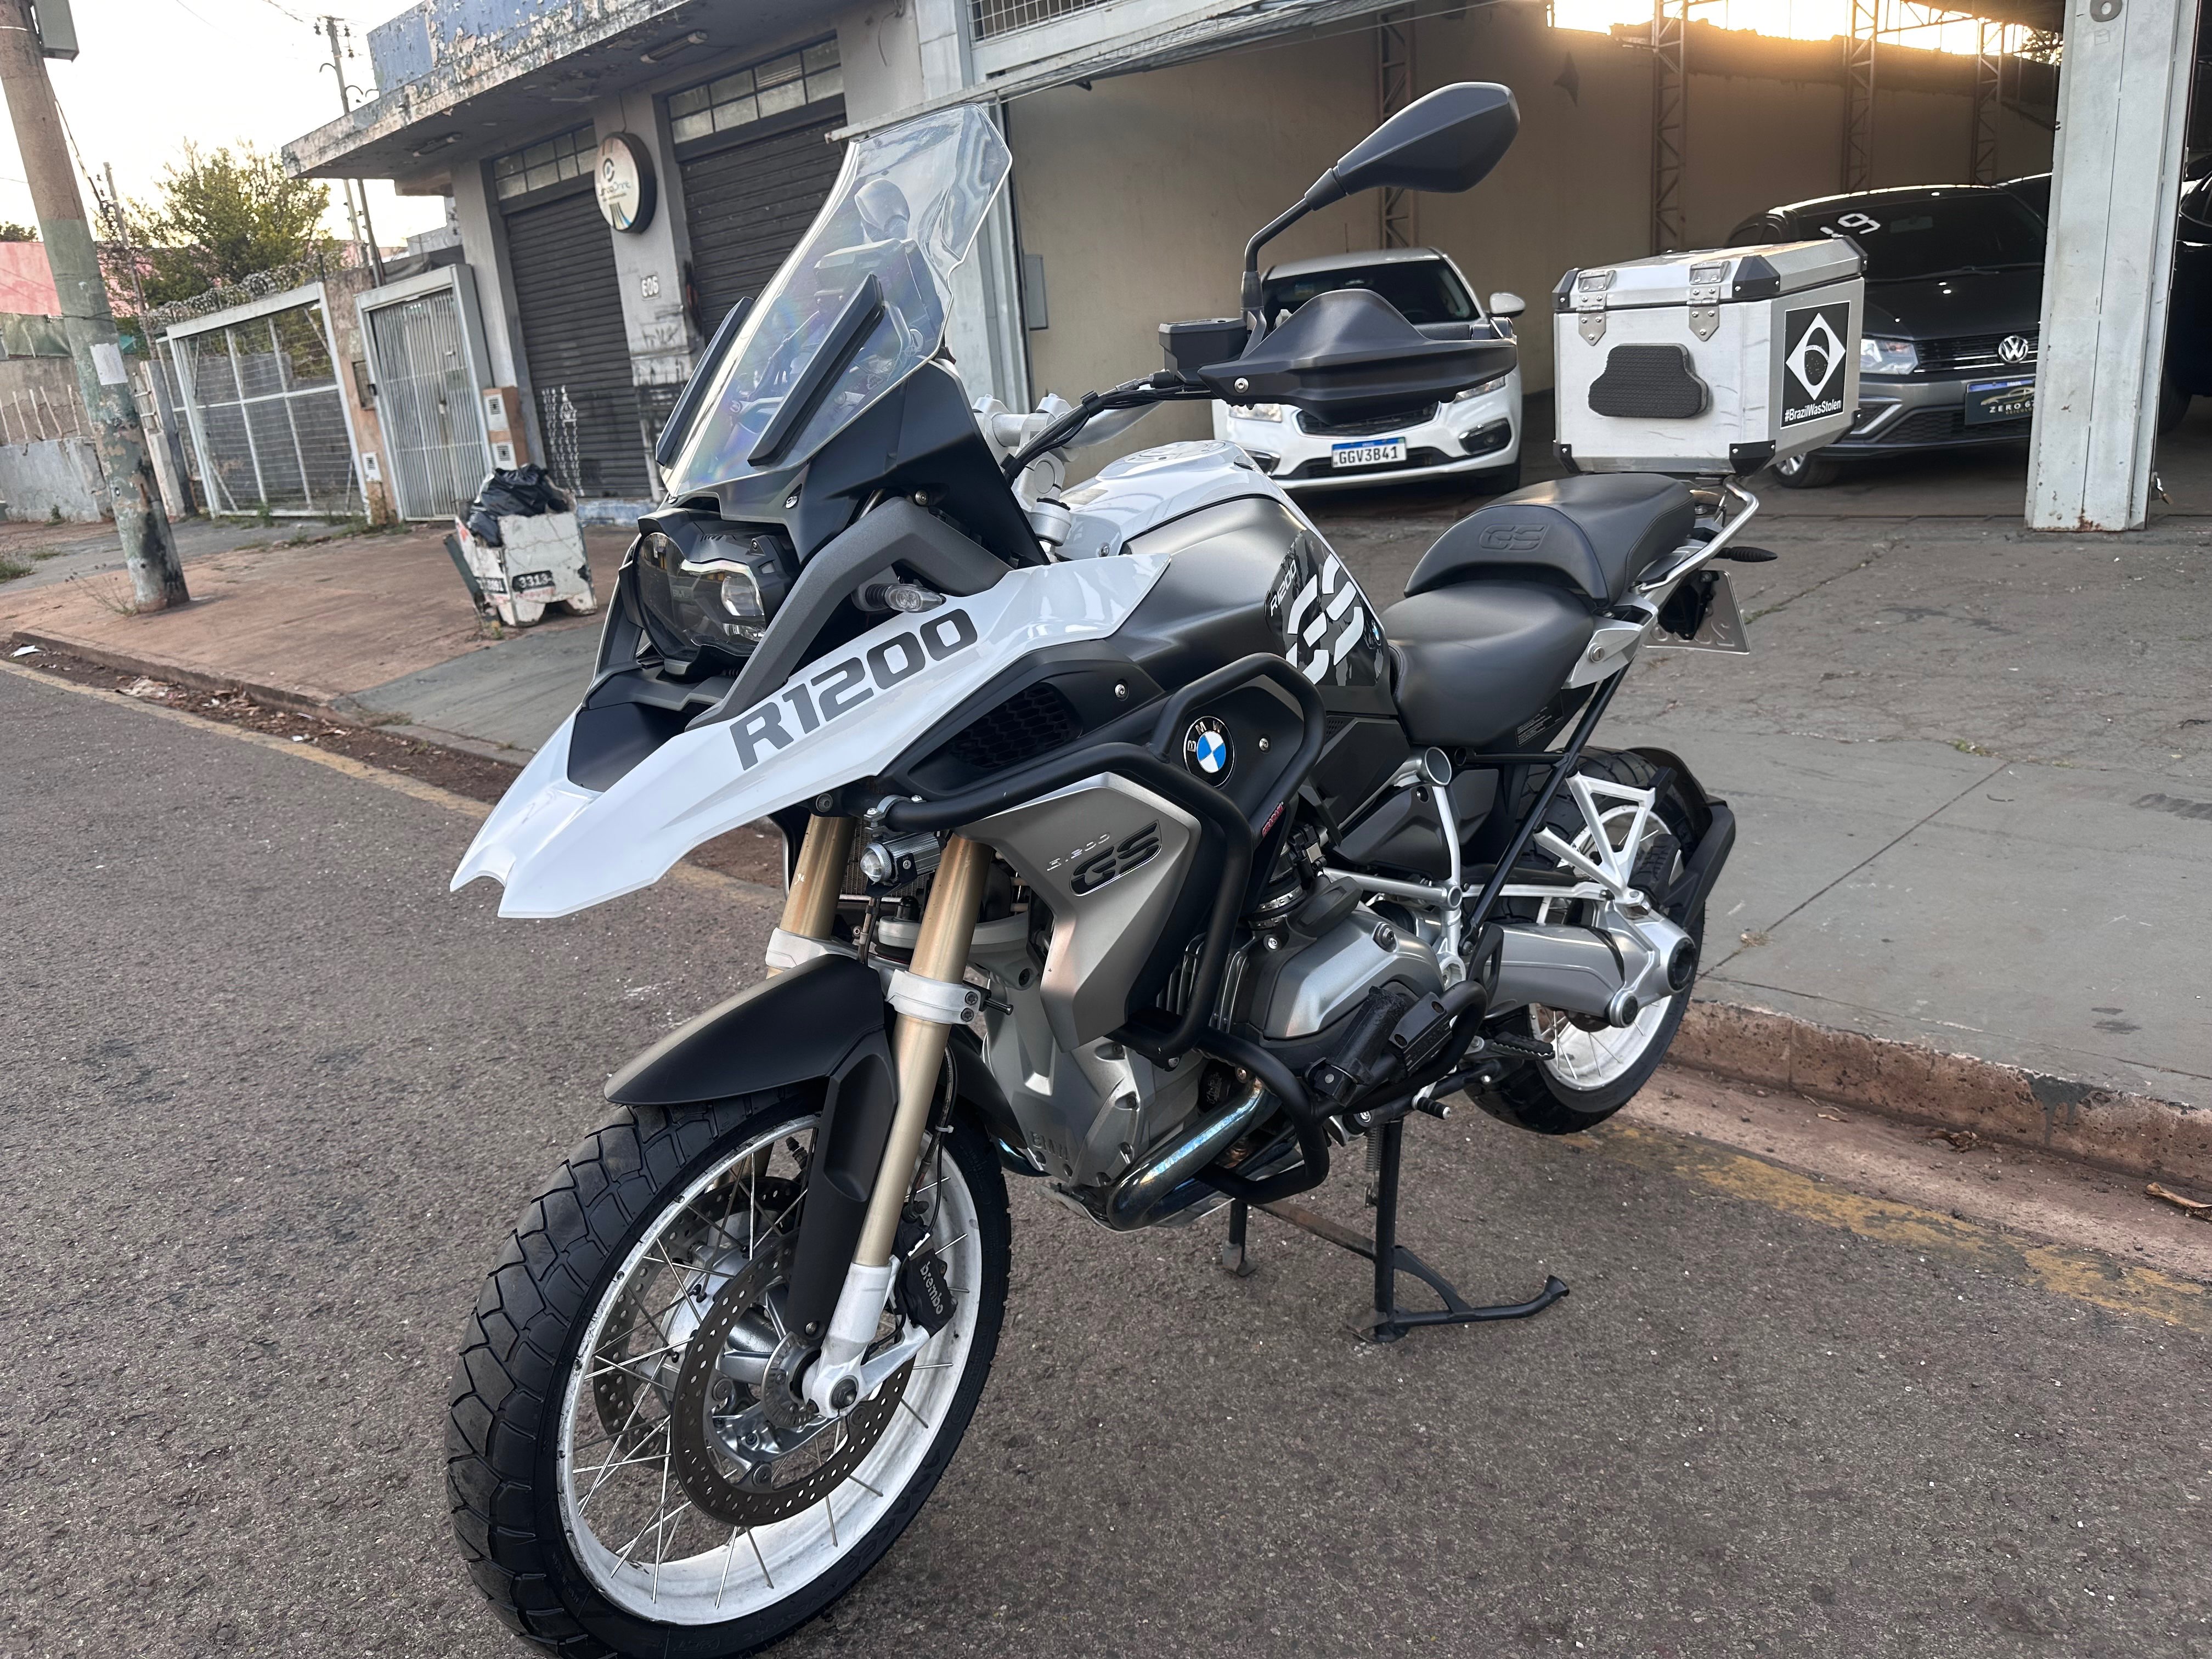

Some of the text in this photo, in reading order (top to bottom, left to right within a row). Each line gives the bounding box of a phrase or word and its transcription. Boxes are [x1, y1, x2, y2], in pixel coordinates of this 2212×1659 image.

[1785, 399, 1841, 422] #BrazilWasStolen
[1989, 403, 2021, 413] ZERO
[1340, 446, 1398, 464] GGV3B41
[1271, 560, 1296, 617] R1200
[730, 608, 978, 771] R1200
[1070, 822, 1160, 895] GS
[920, 1261, 944, 1314] brembo
